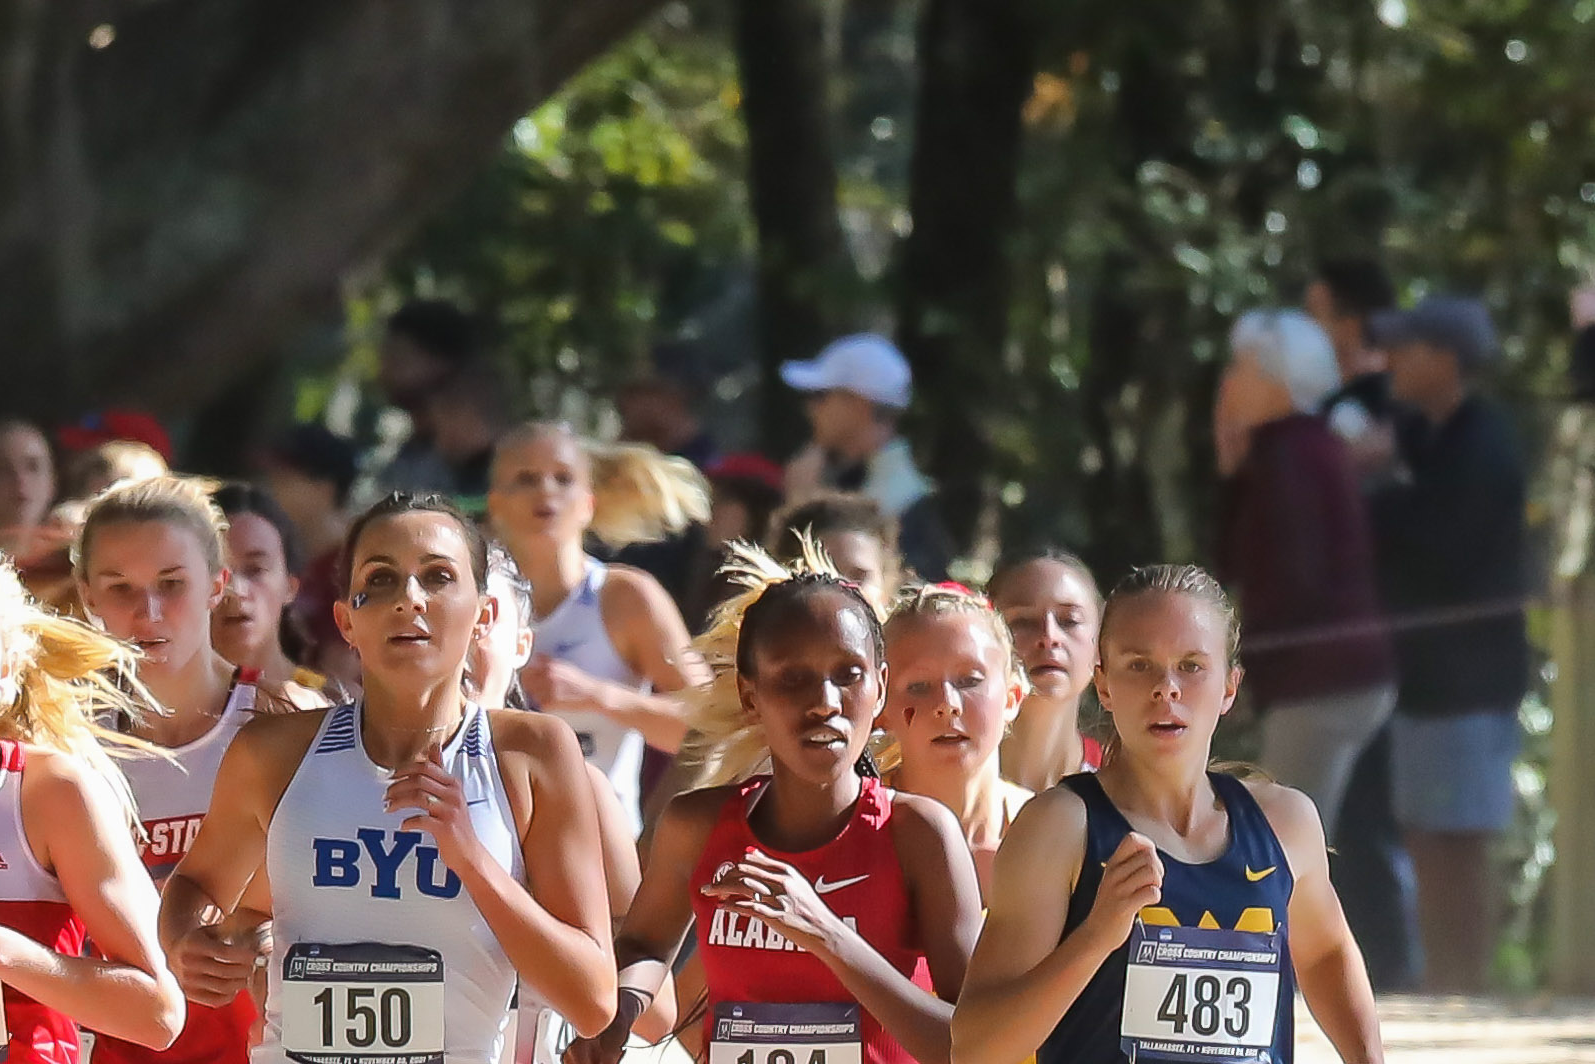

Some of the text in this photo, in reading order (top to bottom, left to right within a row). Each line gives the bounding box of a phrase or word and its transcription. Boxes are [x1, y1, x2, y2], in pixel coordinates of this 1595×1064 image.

[312, 828, 462, 899] BYU
[314, 987, 411, 1048] 150
[1157, 973, 1252, 1038] 483
